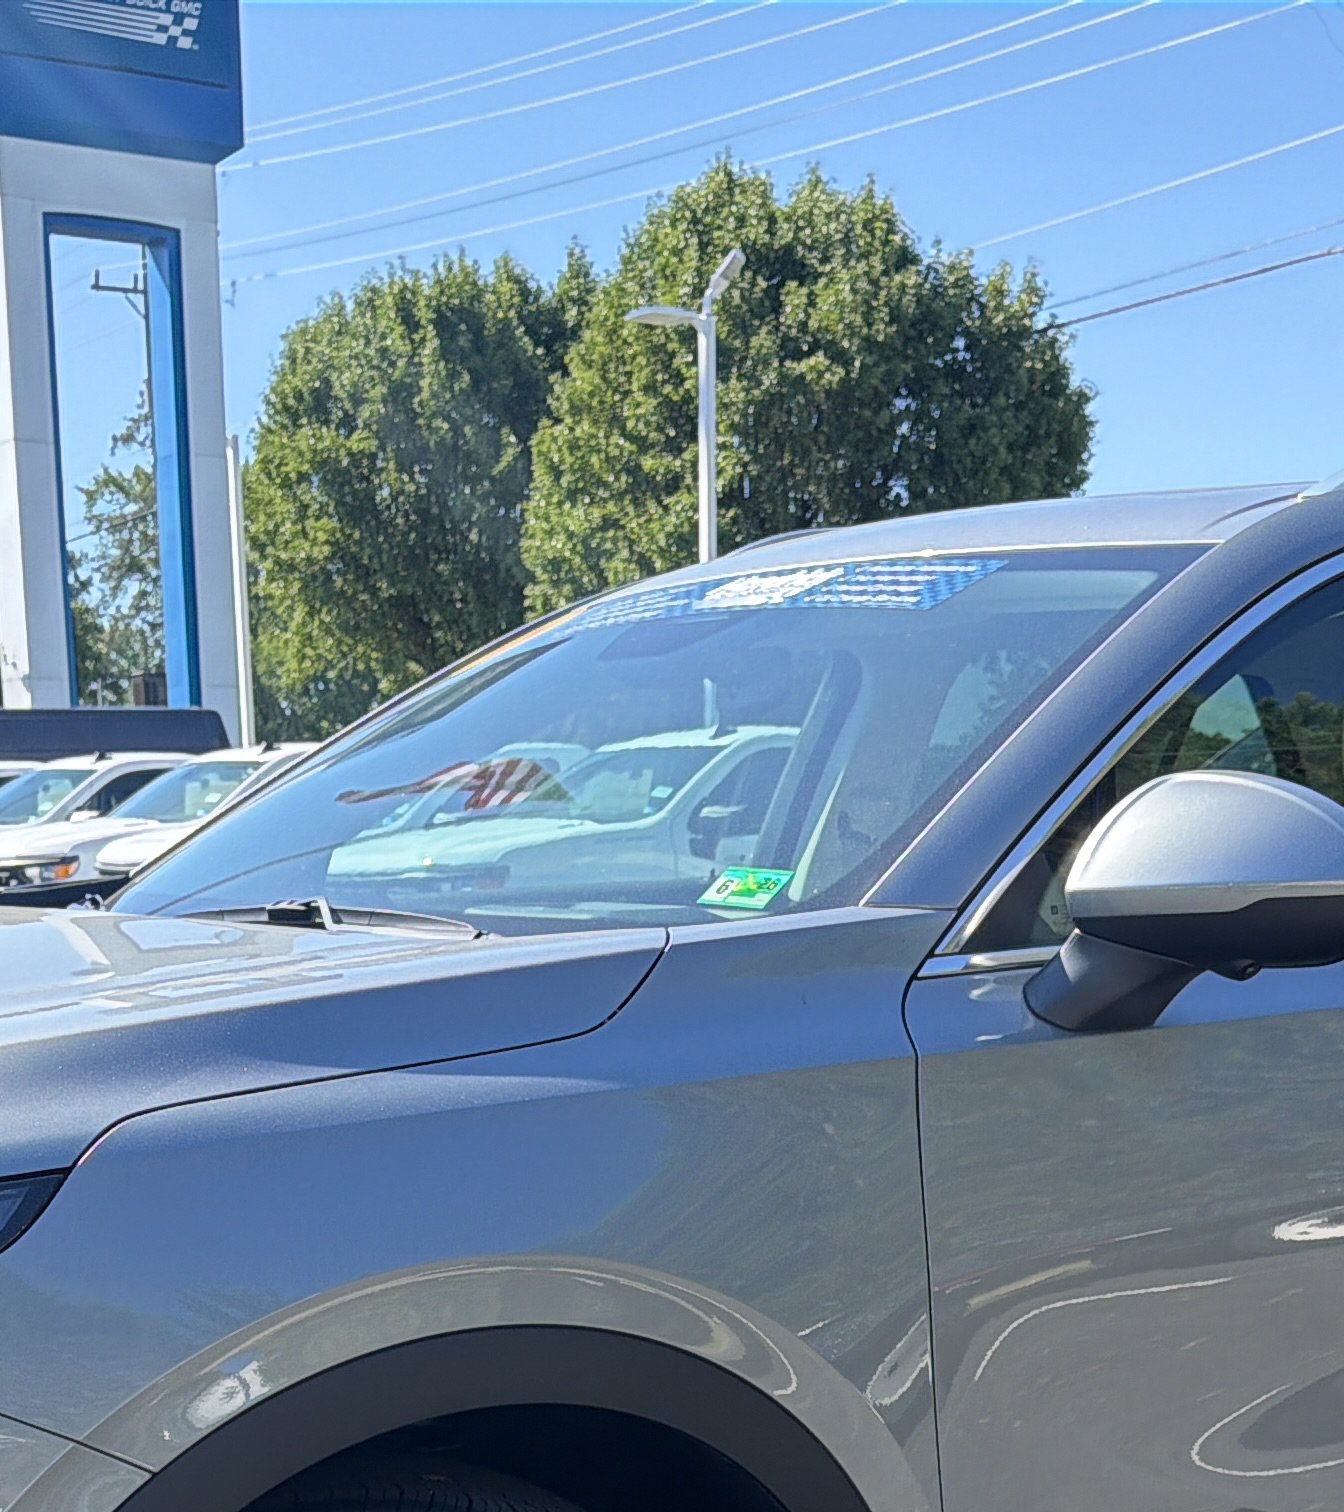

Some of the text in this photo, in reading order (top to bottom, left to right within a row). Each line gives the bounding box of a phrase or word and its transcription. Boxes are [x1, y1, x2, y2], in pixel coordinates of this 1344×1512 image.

[171, 0, 202, 15] GMC
[716, 877, 781, 895] 6 26
